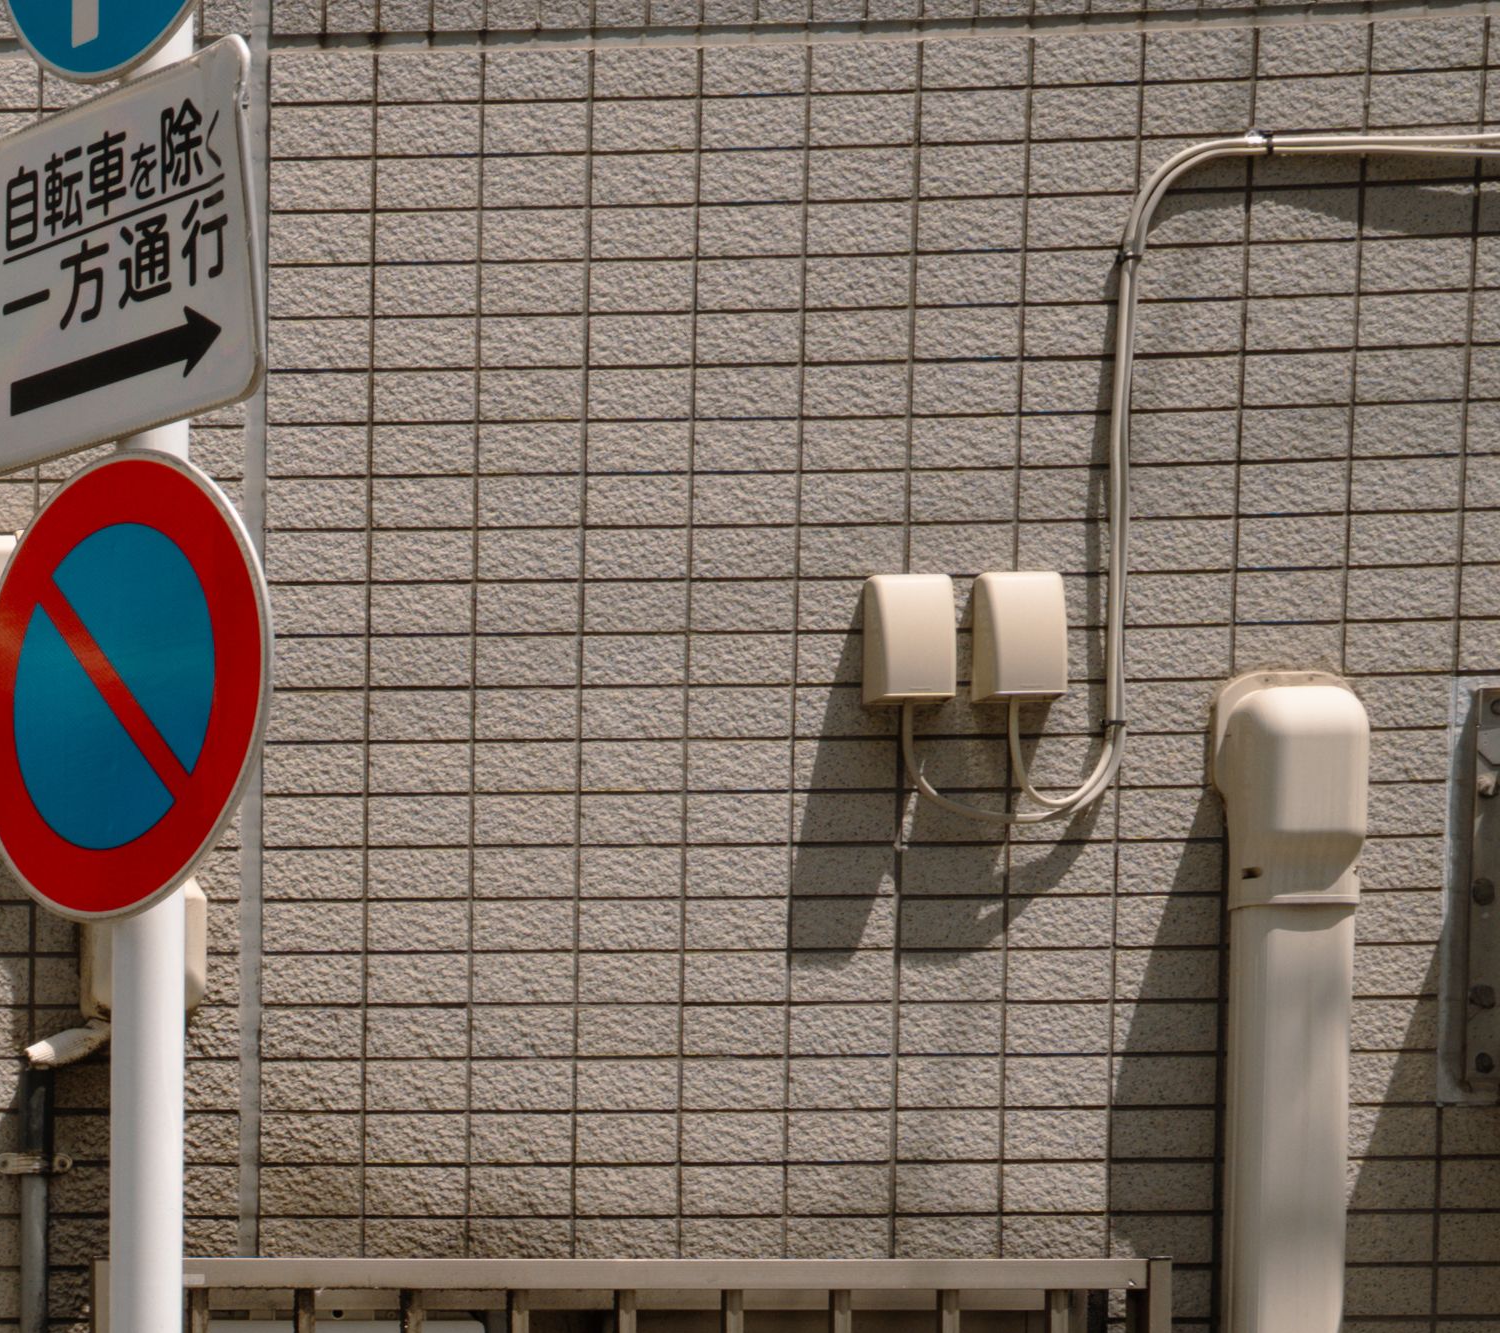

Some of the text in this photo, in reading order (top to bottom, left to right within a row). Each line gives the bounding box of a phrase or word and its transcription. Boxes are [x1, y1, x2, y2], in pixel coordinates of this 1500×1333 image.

[7, 98, 223, 252] 自転車を除く
[3, 190, 228, 330] 一方通行
